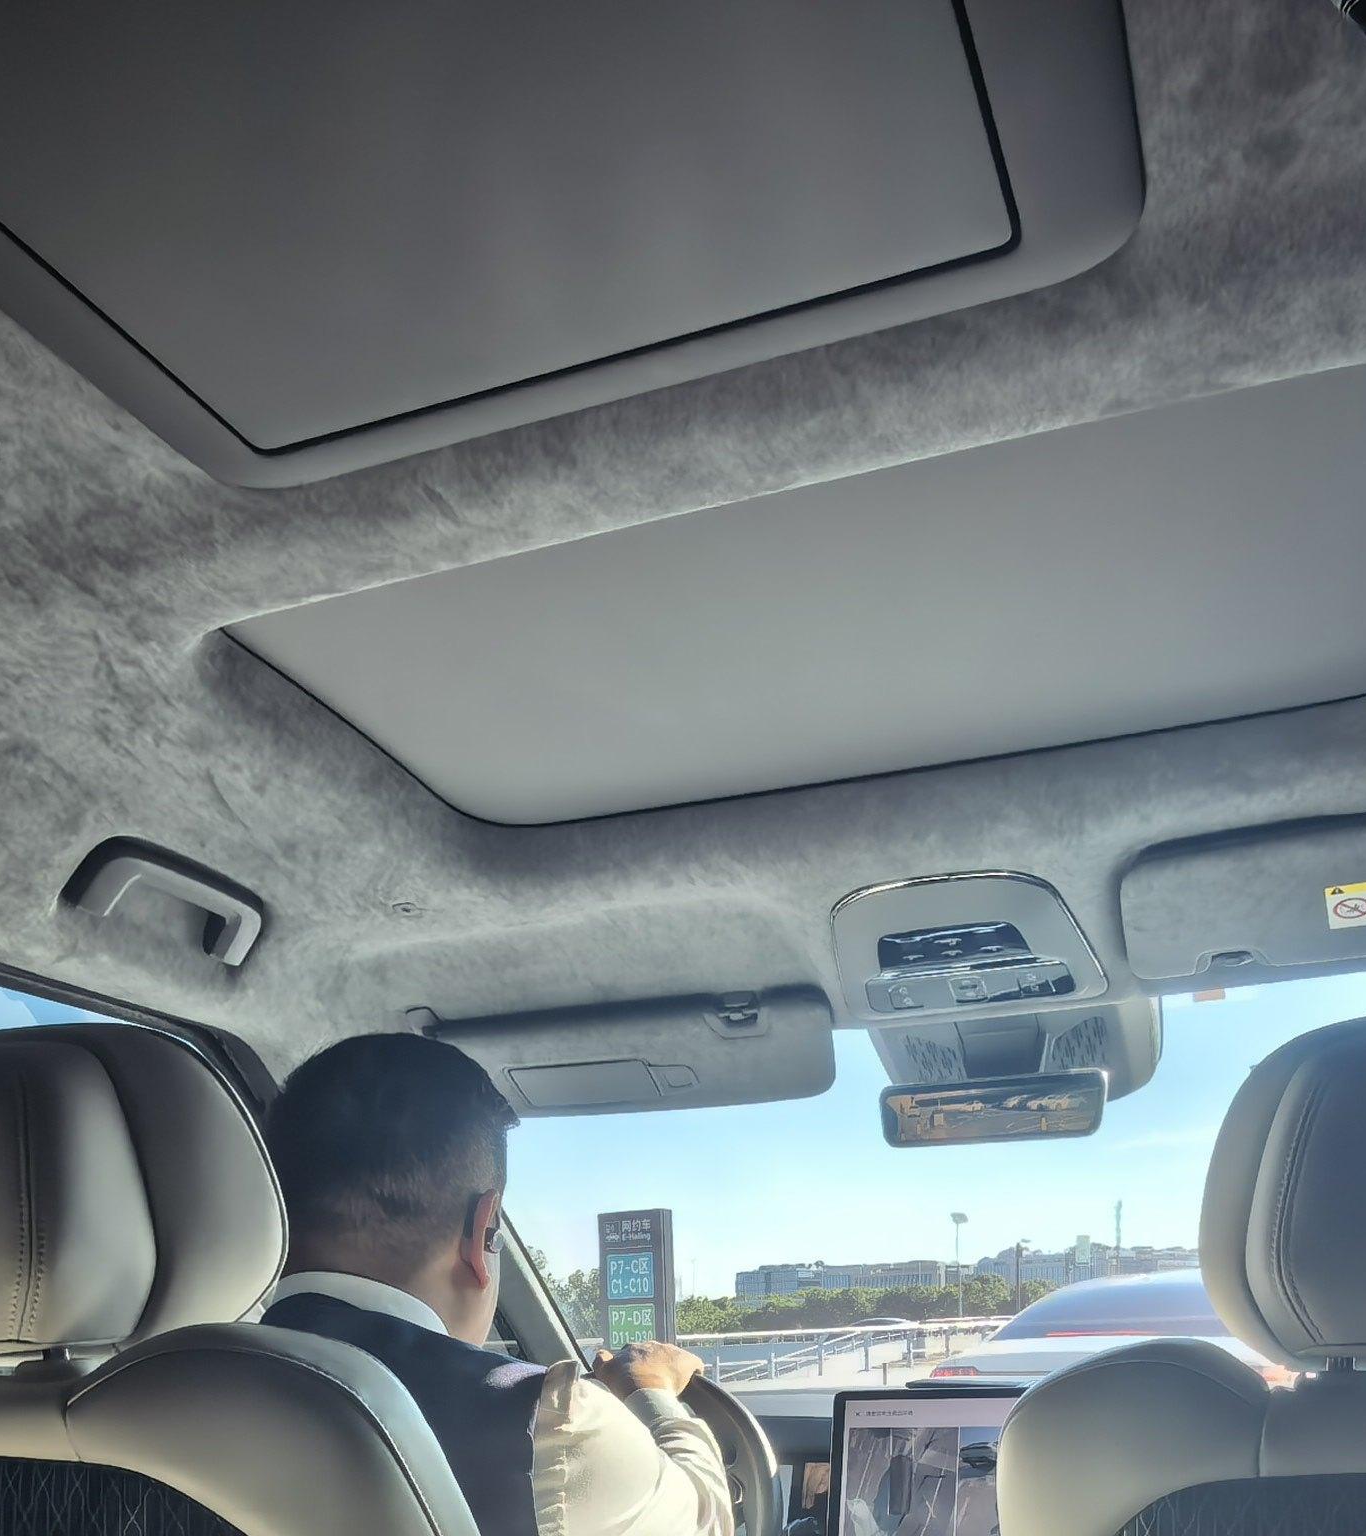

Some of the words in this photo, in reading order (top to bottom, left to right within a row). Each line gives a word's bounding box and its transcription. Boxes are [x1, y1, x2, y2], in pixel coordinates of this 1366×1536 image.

[621, 1219, 651, 1233] 网约车
[610, 1257, 650, 1276] P7-C区
[611, 1277, 649, 1294] C1-C10
[611, 1309, 652, 1326] P7-D区
